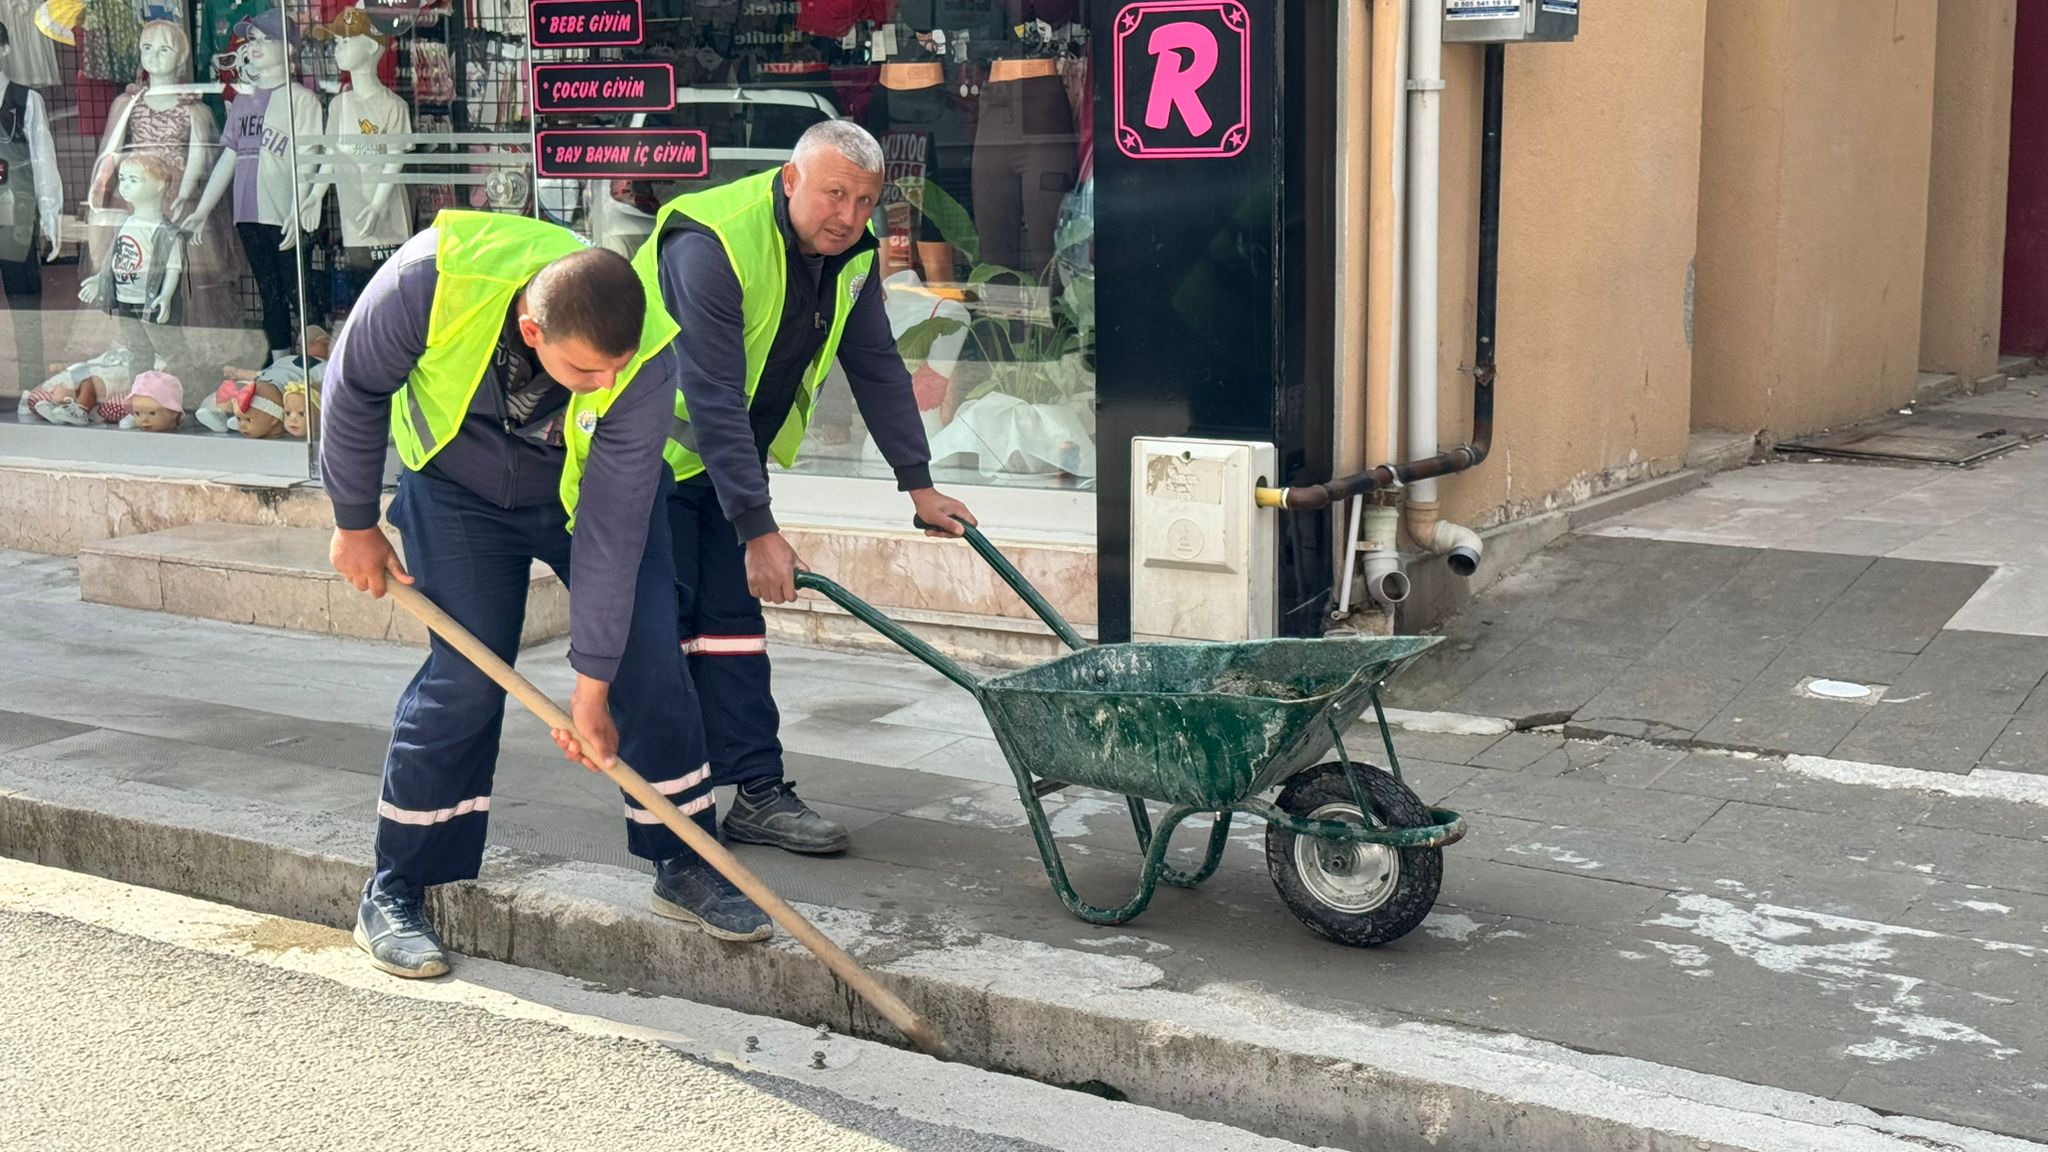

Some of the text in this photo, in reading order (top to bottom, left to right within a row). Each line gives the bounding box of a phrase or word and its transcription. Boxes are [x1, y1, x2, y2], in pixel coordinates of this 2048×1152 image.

[549, 10, 631, 34] BEBE GİYİM
[552, 76, 645, 103] ÇOCUK GİYİM
[1144, 21, 1219, 138] R
[555, 140, 697, 166] BAY BAYAN İÇ GİYİM
